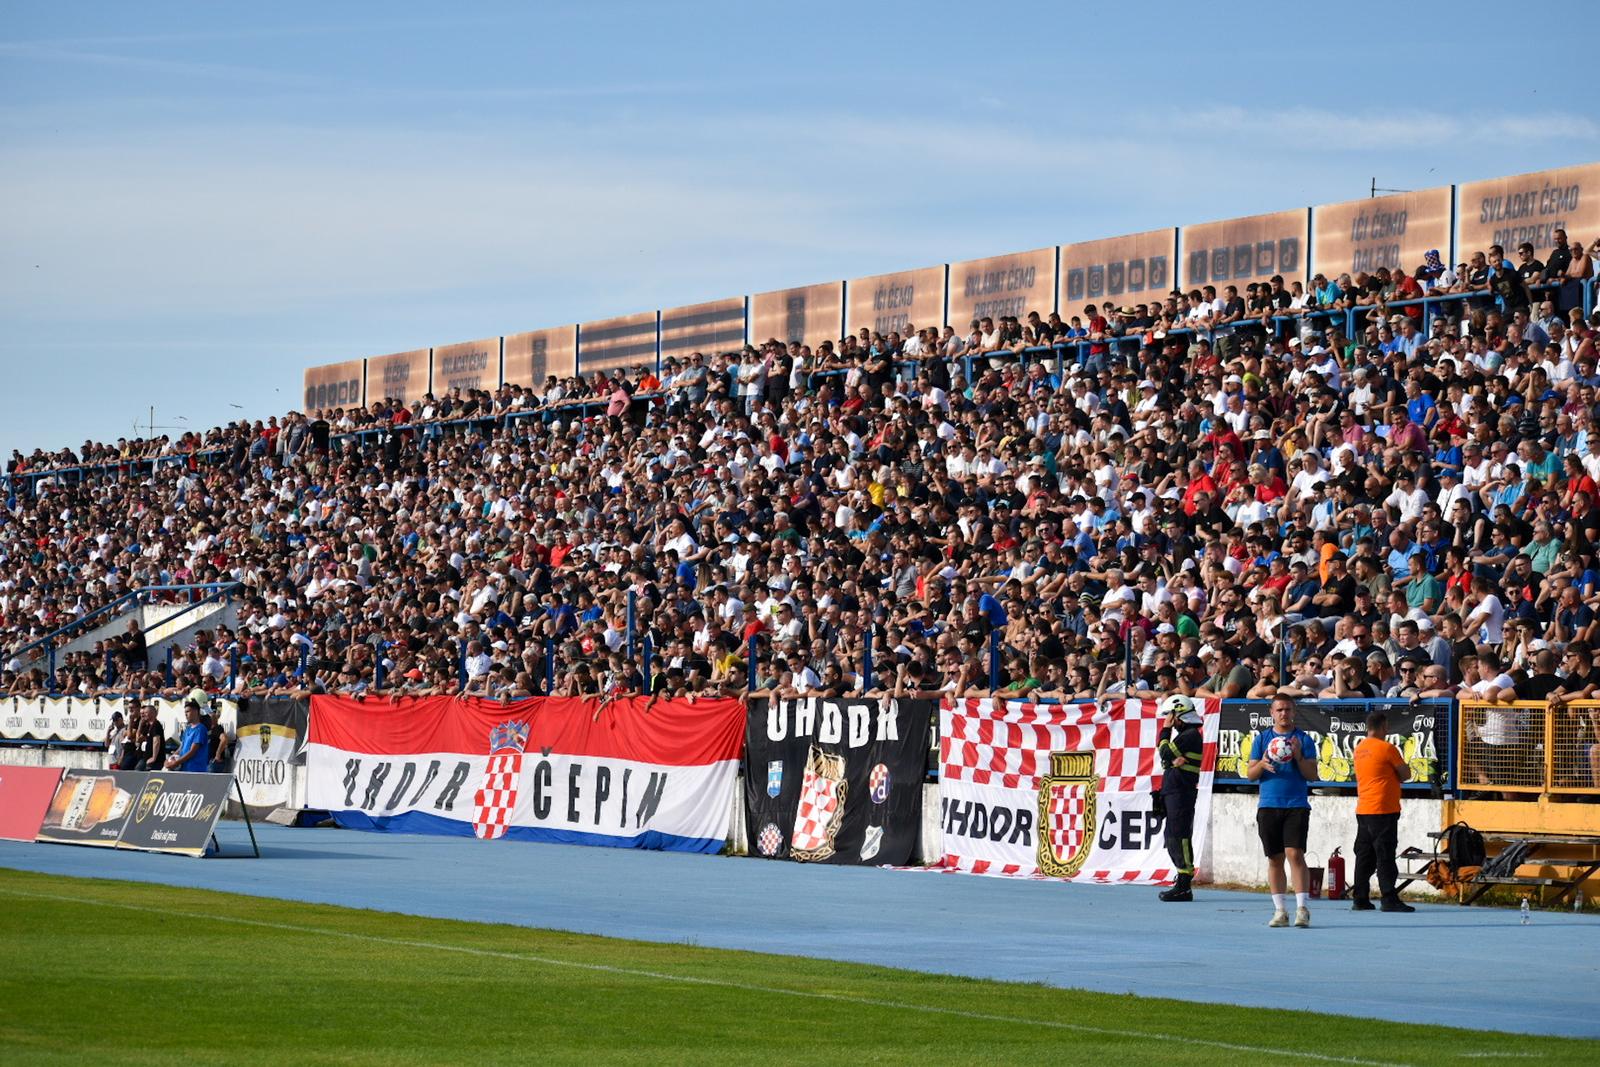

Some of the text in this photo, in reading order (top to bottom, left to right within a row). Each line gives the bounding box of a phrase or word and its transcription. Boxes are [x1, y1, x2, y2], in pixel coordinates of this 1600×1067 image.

[1480, 181, 1579, 224] SVLADAT ĆEMO
[1219, 729, 1241, 757] ER
[238, 756, 285, 790] OSJEČKO
[533, 745, 668, 829] ČEPIN
[153, 789, 204, 822] OSJEČKO
